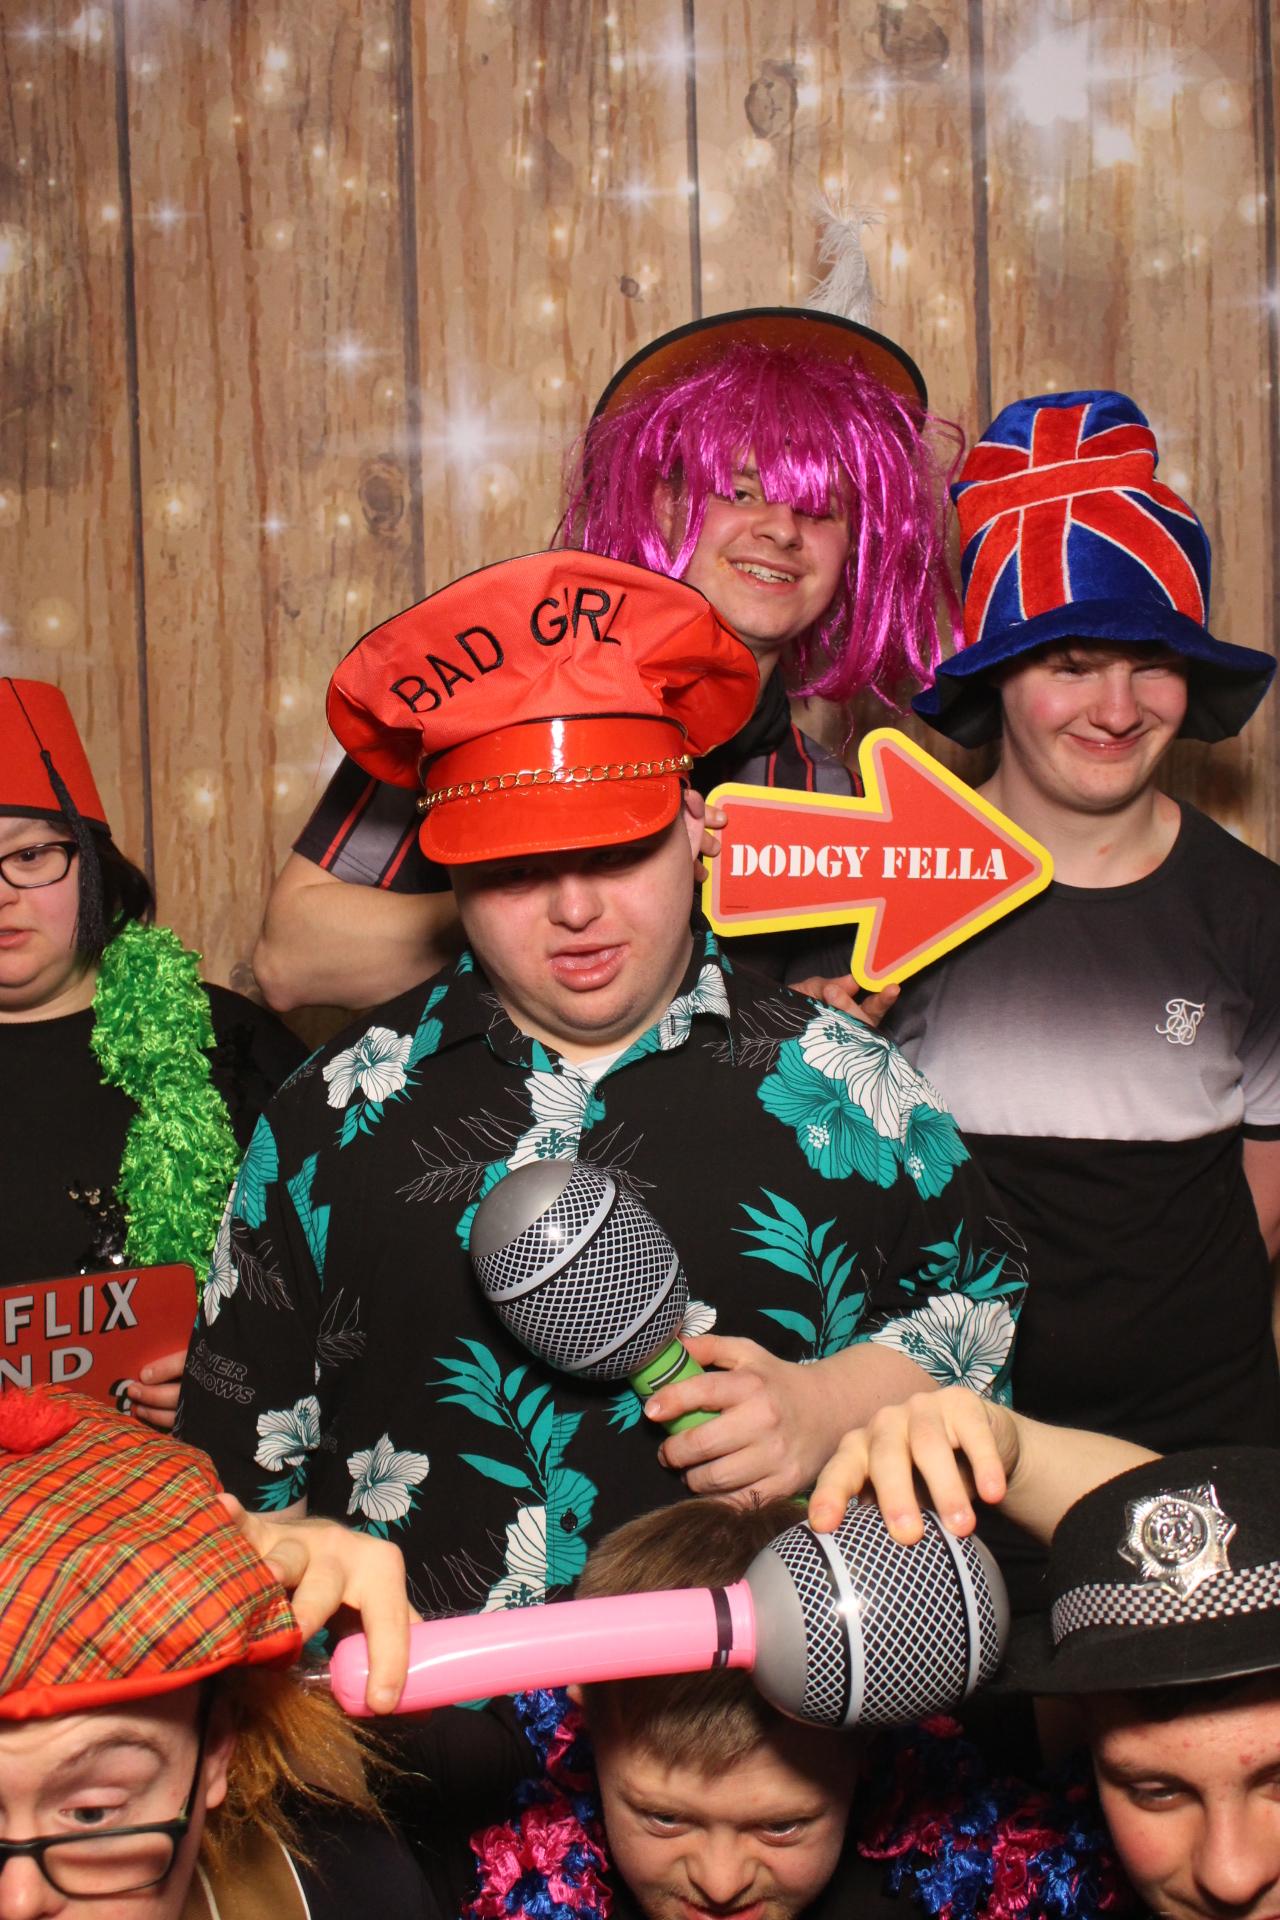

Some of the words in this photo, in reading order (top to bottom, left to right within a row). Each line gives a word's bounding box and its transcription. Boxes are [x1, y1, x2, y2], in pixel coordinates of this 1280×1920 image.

[389, 625, 505, 714] BAD
[730, 844, 870, 878] DODGY
[881, 846, 1009, 881] FELLA
[4, 1277, 139, 1346] FLIX
[0, 1346, 94, 1390] ND
